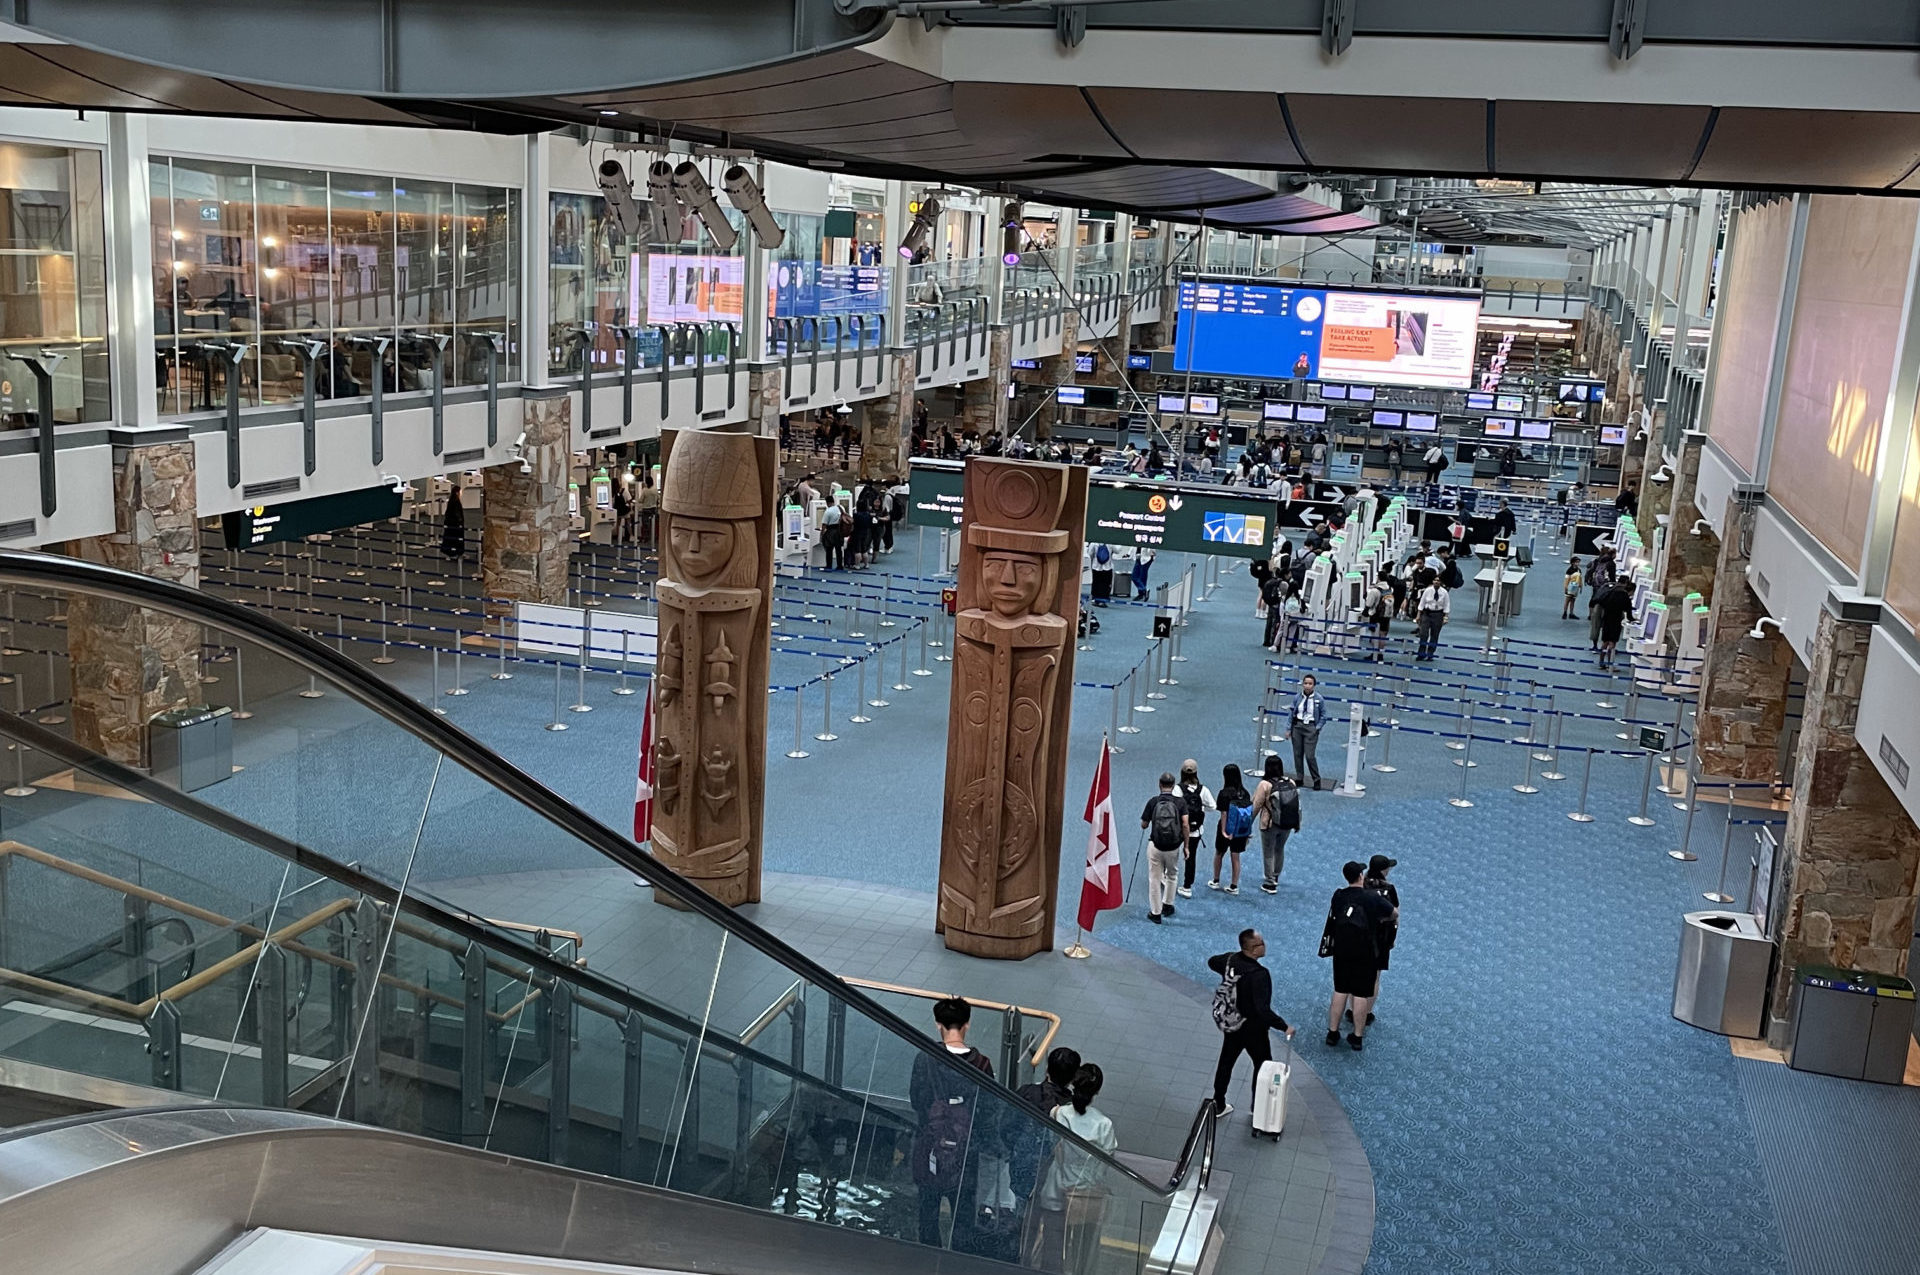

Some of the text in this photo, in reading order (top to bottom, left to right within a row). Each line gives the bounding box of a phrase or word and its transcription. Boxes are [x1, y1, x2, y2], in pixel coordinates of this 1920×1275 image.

[1119, 511, 1166, 523] Passport Control
[1098, 519, 1165, 533] Contrôle des passeports
[1204, 523, 1264, 546] YVR
